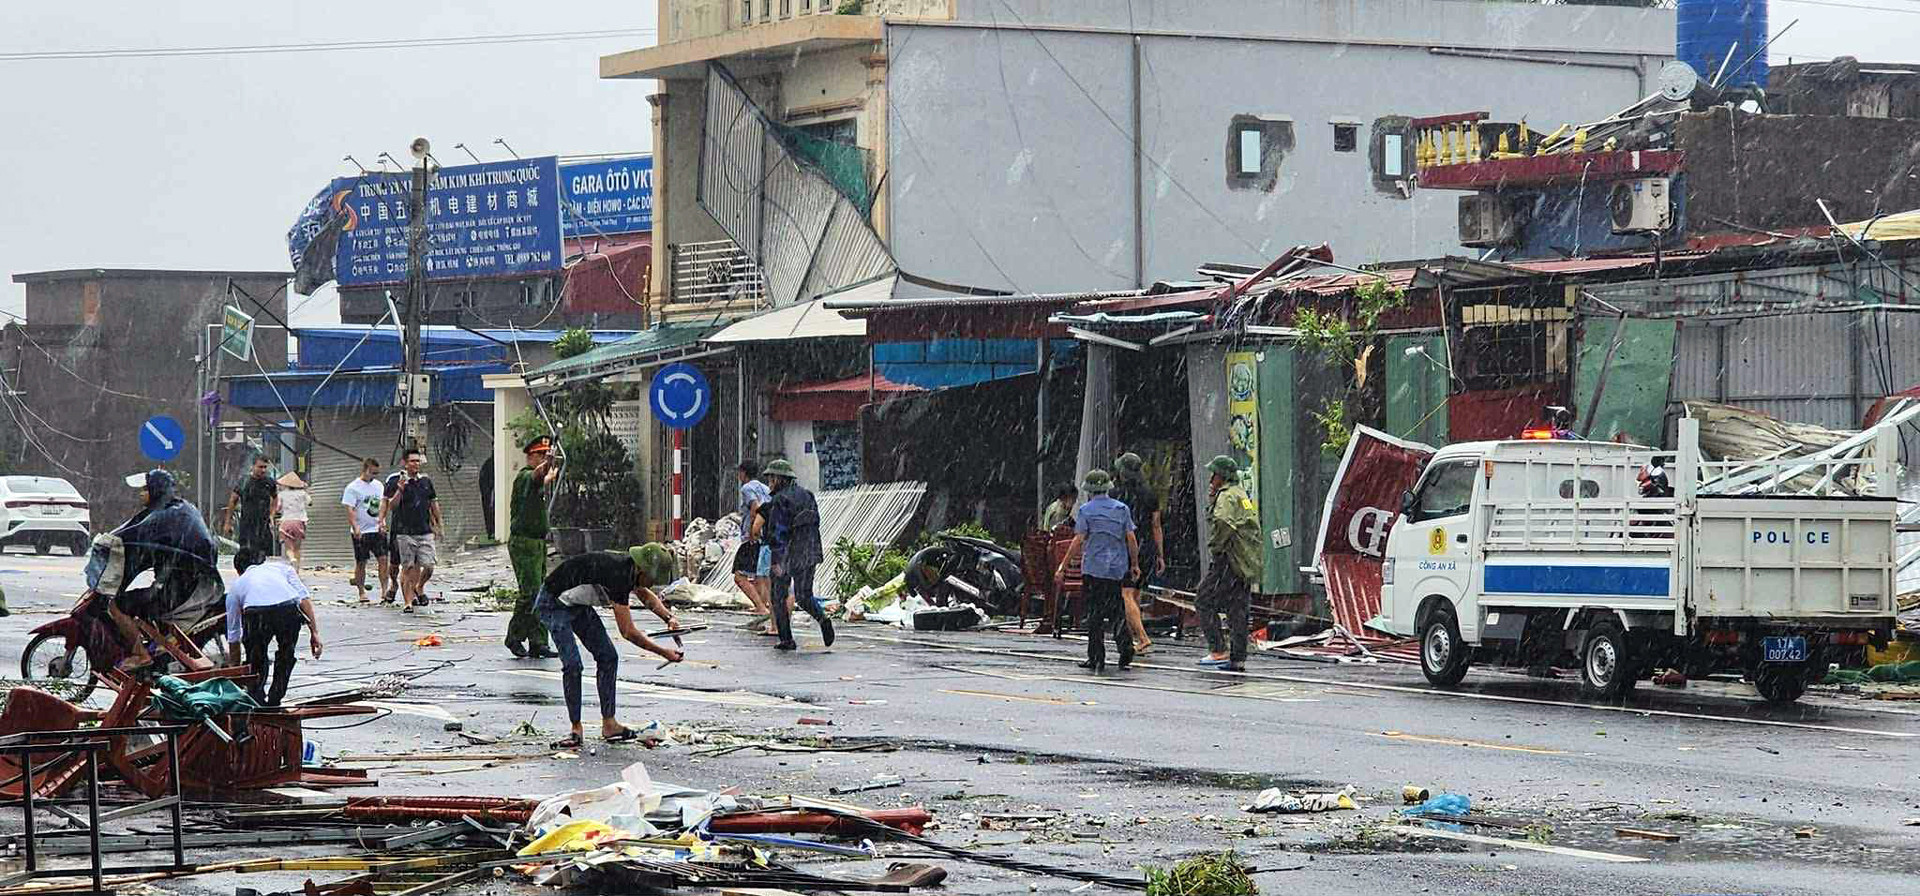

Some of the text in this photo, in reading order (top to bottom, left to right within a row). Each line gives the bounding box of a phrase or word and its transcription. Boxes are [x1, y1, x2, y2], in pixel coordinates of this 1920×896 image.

[449, 174, 468, 189] KIM
[469, 166, 486, 187] KHÍ
[487, 169, 515, 185] TRUNG
[516, 160, 540, 184] QUỐC
[572, 174, 603, 195] GARA
[606, 166, 629, 191] ÔTÔ
[1418, 560, 1437, 570] CÔNG
[1438, 562, 1446, 570] AN
